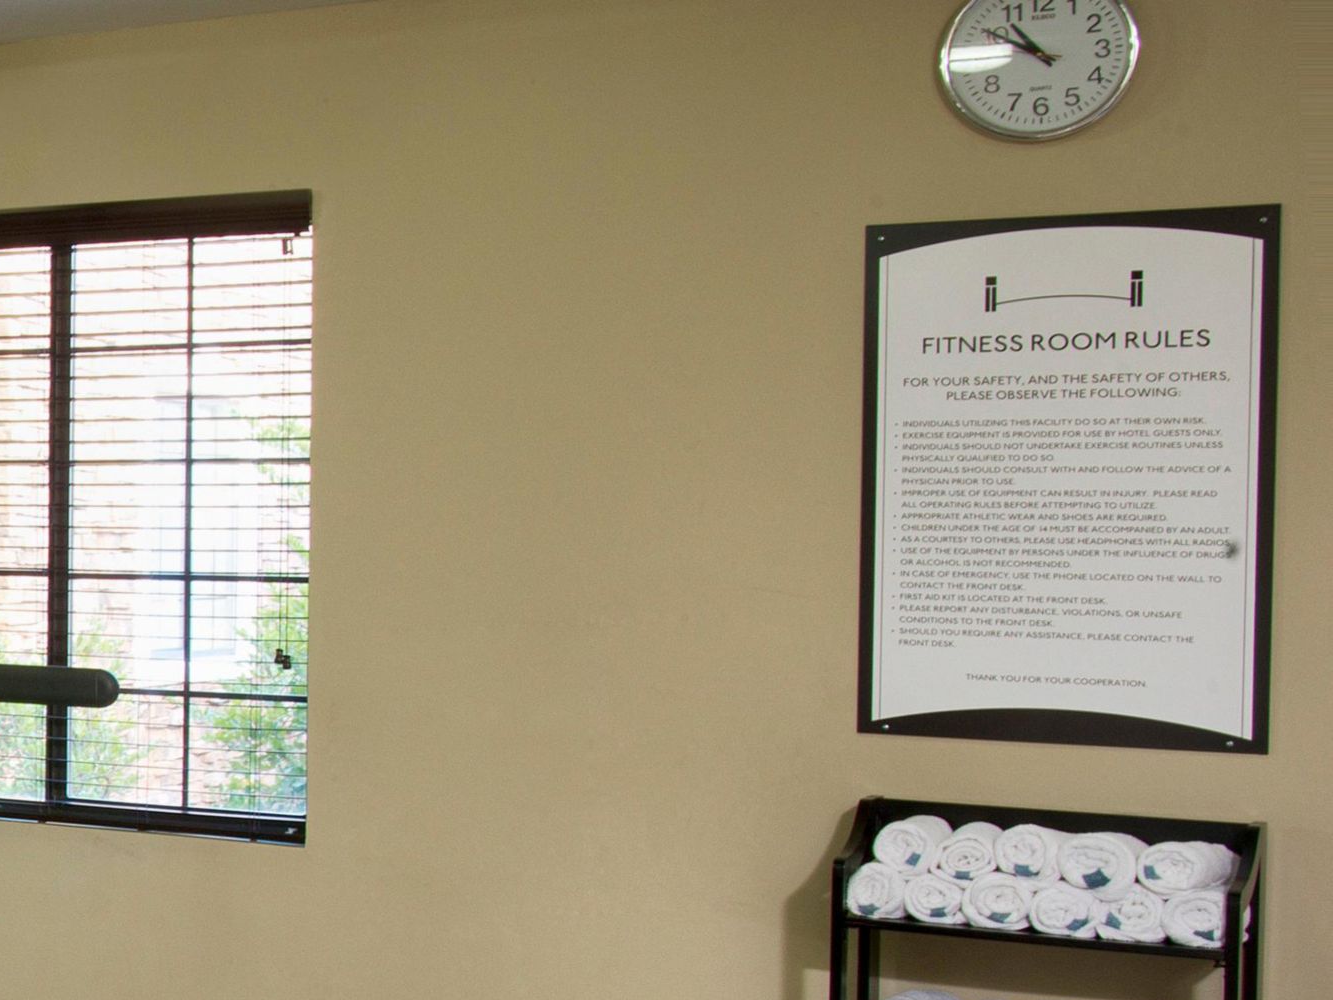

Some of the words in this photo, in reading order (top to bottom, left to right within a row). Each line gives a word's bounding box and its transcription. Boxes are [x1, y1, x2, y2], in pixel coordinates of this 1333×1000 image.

[1002, 3, 1023, 22] 11
[1087, 13, 1102, 34] 2
[1095, 39, 1111, 58] 3
[1087, 65, 1104, 84] 4
[984, 74, 1000, 94] 8
[1008, 92, 1022, 112] 7
[1064, 86, 1081, 107] 5
[1033, 97, 1049, 116] 6
[922, 333, 1023, 354] FITNESS
[1031, 331, 1117, 352] ROOM
[1124, 328, 1210, 349] RULES
[903, 377, 929, 388] FOR
[933, 376, 970, 387] YOUR
[973, 375, 1026, 386] SAFETY,
[1028, 374, 1059, 385] AND
[1062, 374, 1088, 385] THE
[1091, 373, 1142, 384] SAFETY
[1145, 373, 1165, 383] OF
[1168, 371, 1231, 383] OTHERS,
[946, 389, 993, 400] PLEASE
[996, 389, 1057, 400] OBSERVE
[1062, 388, 1087, 399] THE
[1090, 387, 1183, 399] FOLLOWING:
[902, 419, 961, 428] INDIVIDUALS
[962, 419, 1009, 427] UTILIZING
[1011, 418, 1032, 427] THIS
[1032, 418, 1073, 427] FACILITY
[1074, 418, 1091, 426] DO
[1092, 418, 1108, 426] SO
[1109, 418, 1121, 426] AT
[1124, 417, 1152, 426] THEIR
[1153, 417, 1182, 425] OWN
[902, 431, 945, 440] EXERCISE
[946, 431, 1000, 439] EQUIPMENT
[1002, 431, 1011, 439] IS
[1012, 430, 1061, 439] PROVIDED
[1062, 430, 1082, 438] FOR
[1083, 430, 1103, 438] USE
[1104, 430, 1116, 438] BY
[1118, 430, 1151, 438] HOTEL
[1153, 429, 1192, 438] GUESTS
[901, 489, 947, 497] IMPROPER
[948, 489, 967, 497] USE
[968, 489, 981, 497] OF
[982, 489, 1038, 497] EQUIPMENT
[1040, 489, 1062, 497] CAN
[1063, 489, 1098, 497] RESULT
[1100, 489, 1111, 497] IN
[1153, 489, 1189, 498] PLEASE
[1190, 489, 1218, 498] READ
[900, 569, 911, 578] IN
[911, 570, 936, 578] CASE
[936, 570, 950, 578] OF
[1012, 571, 1031, 580] USE
[1033, 572, 1051, 580] THE
[1053, 572, 1088, 581] PHONE
[1089, 573, 1135, 582] LOCATED
[1136, 573, 1154, 582] ON
[1156, 574, 1175, 582] THE
[1177, 574, 1204, 583] WALL
[1208, 575, 1222, 583] TO
[899, 581, 944, 590] CONTACT
[947, 582, 965, 590] THE
[966, 582, 997, 591] FRONT
[899, 592, 924, 601] FIRST
[924, 593, 941, 601] AID
[942, 593, 956, 602] KIT
[957, 594, 967, 602] IS
[967, 594, 1011, 603] LOCATED
[1012, 595, 1024, 603] AT
[1026, 595, 1045, 604] THE
[1046, 596, 1079, 605] FRONT
[899, 604, 932, 613] PLEASE
[933, 605, 968, 614] REPORT
[969, 606, 990, 614] ANY
[1125, 610, 1141, 618] OR
[1142, 610, 1183, 619] UNSAFE
[899, 616, 959, 625] CONDITIONS
[961, 617, 974, 626] TO
[976, 618, 993, 626] THE
[994, 618, 1026, 627] FRONT
[898, 638, 929, 647] FRONT
[899, 627, 939, 636] SHOULD
[940, 628, 961, 637] YOU
[962, 629, 1002, 638] REQUIRE
[1004, 630, 1023, 639] ANY
[1087, 632, 1122, 641] PLEASE
[1123, 633, 1172, 643] CONTACT
[1176, 635, 1194, 644] THE
[966, 673, 998, 682] THANK
[1000, 674, 1022, 683] YOU
[1022, 675, 1043, 684] FOR
[1044, 676, 1072, 685] YOUR
